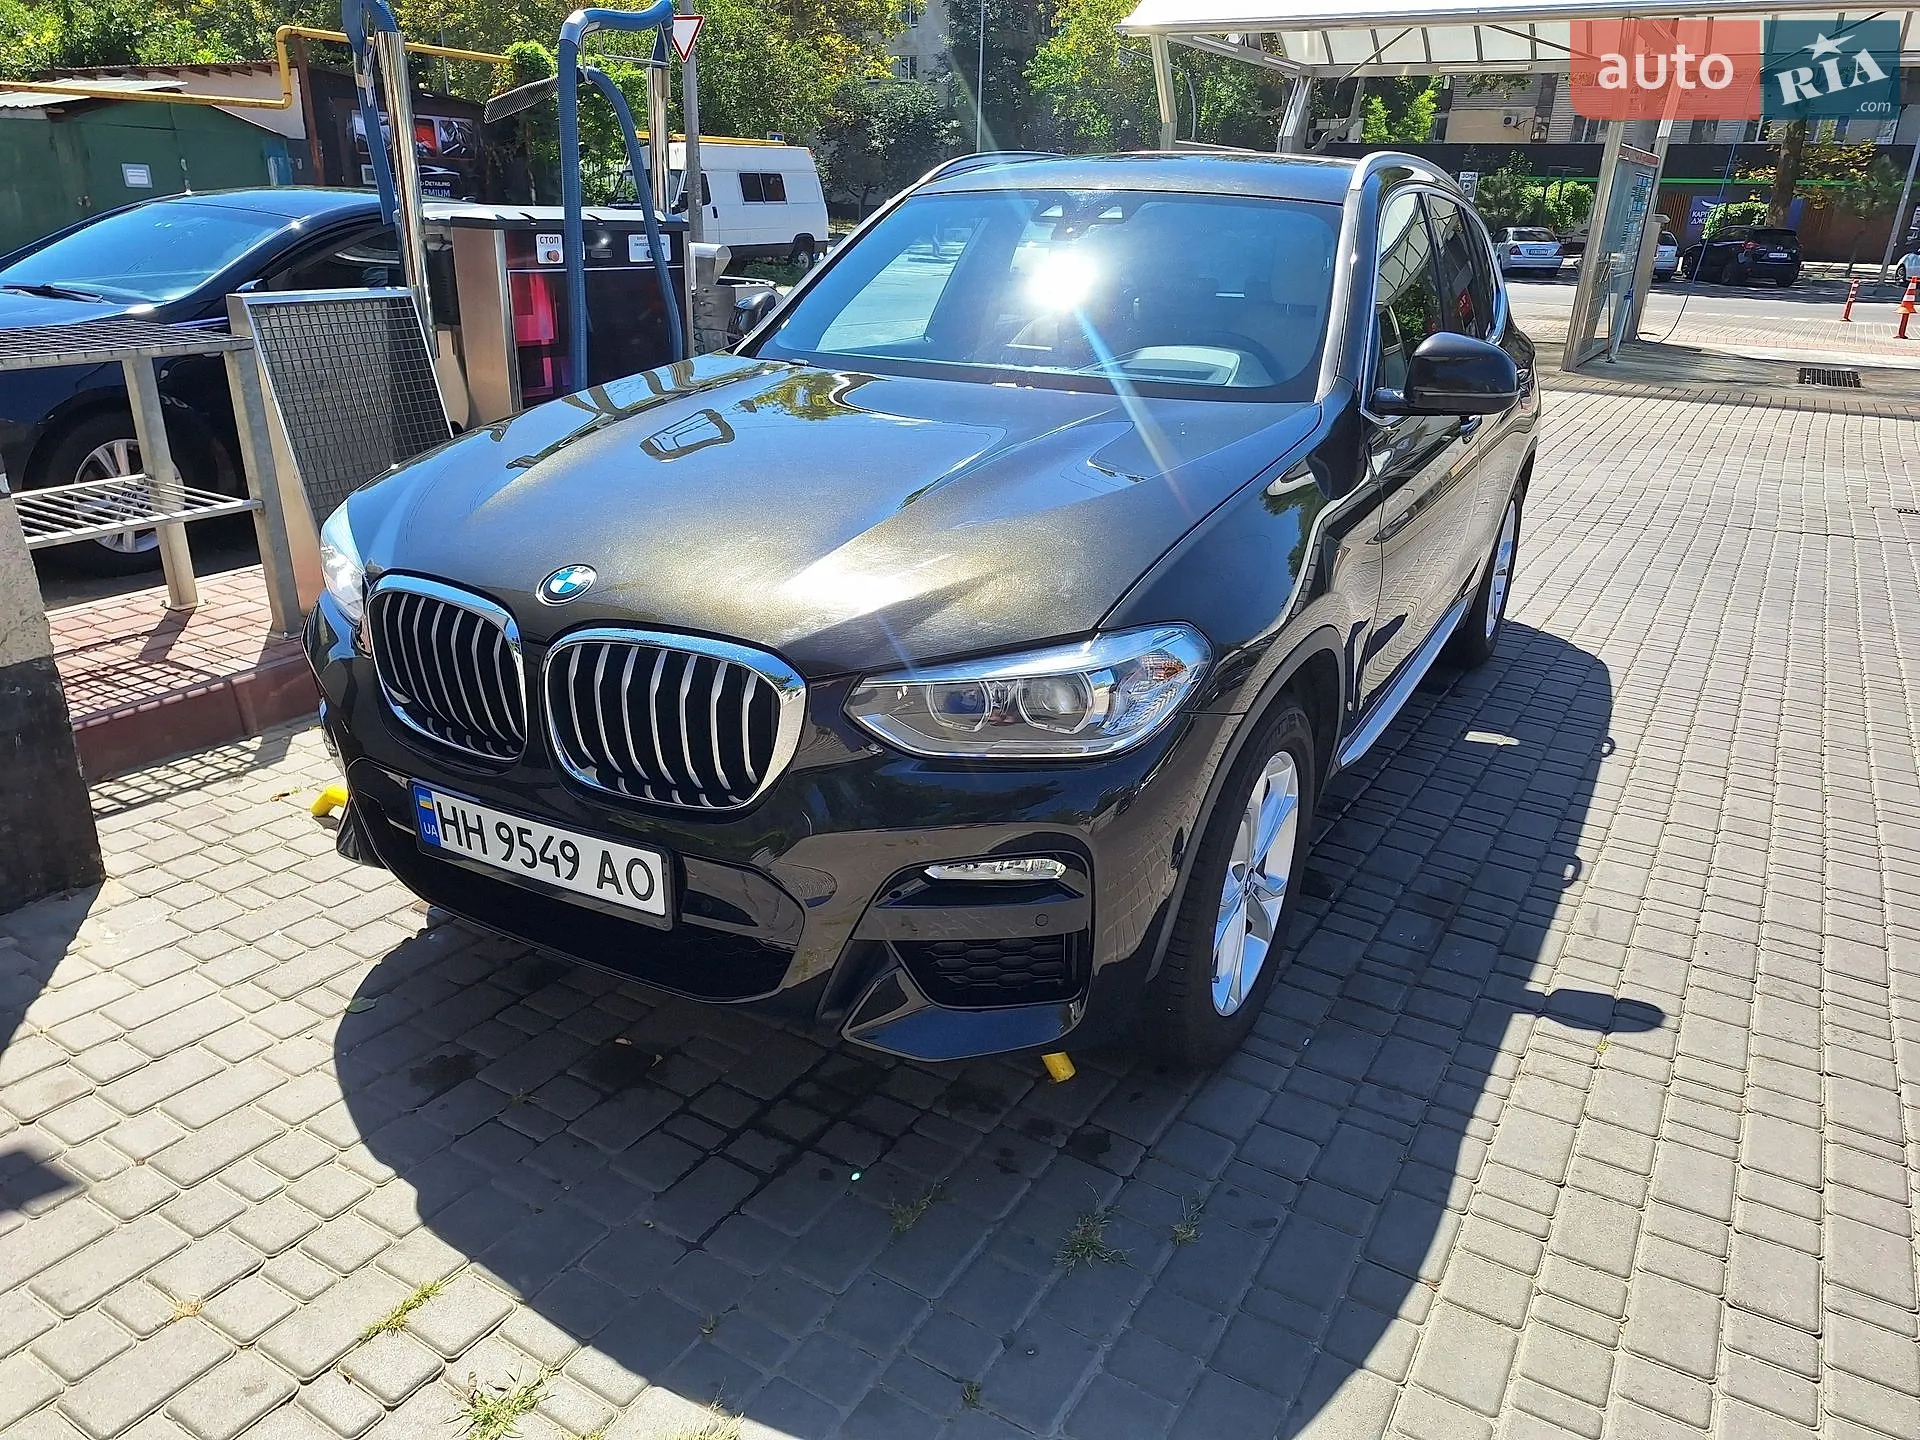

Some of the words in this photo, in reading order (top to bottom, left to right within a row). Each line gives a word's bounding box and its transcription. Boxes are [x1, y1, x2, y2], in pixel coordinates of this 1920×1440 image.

[421, 188, 450, 197] EMIUM
[539, 235, 560, 245] СТОП
[424, 821, 438, 837] UA
[437, 801, 487, 855] HH
[495, 821, 580, 881] 9549
[597, 850, 655, 902] AO
